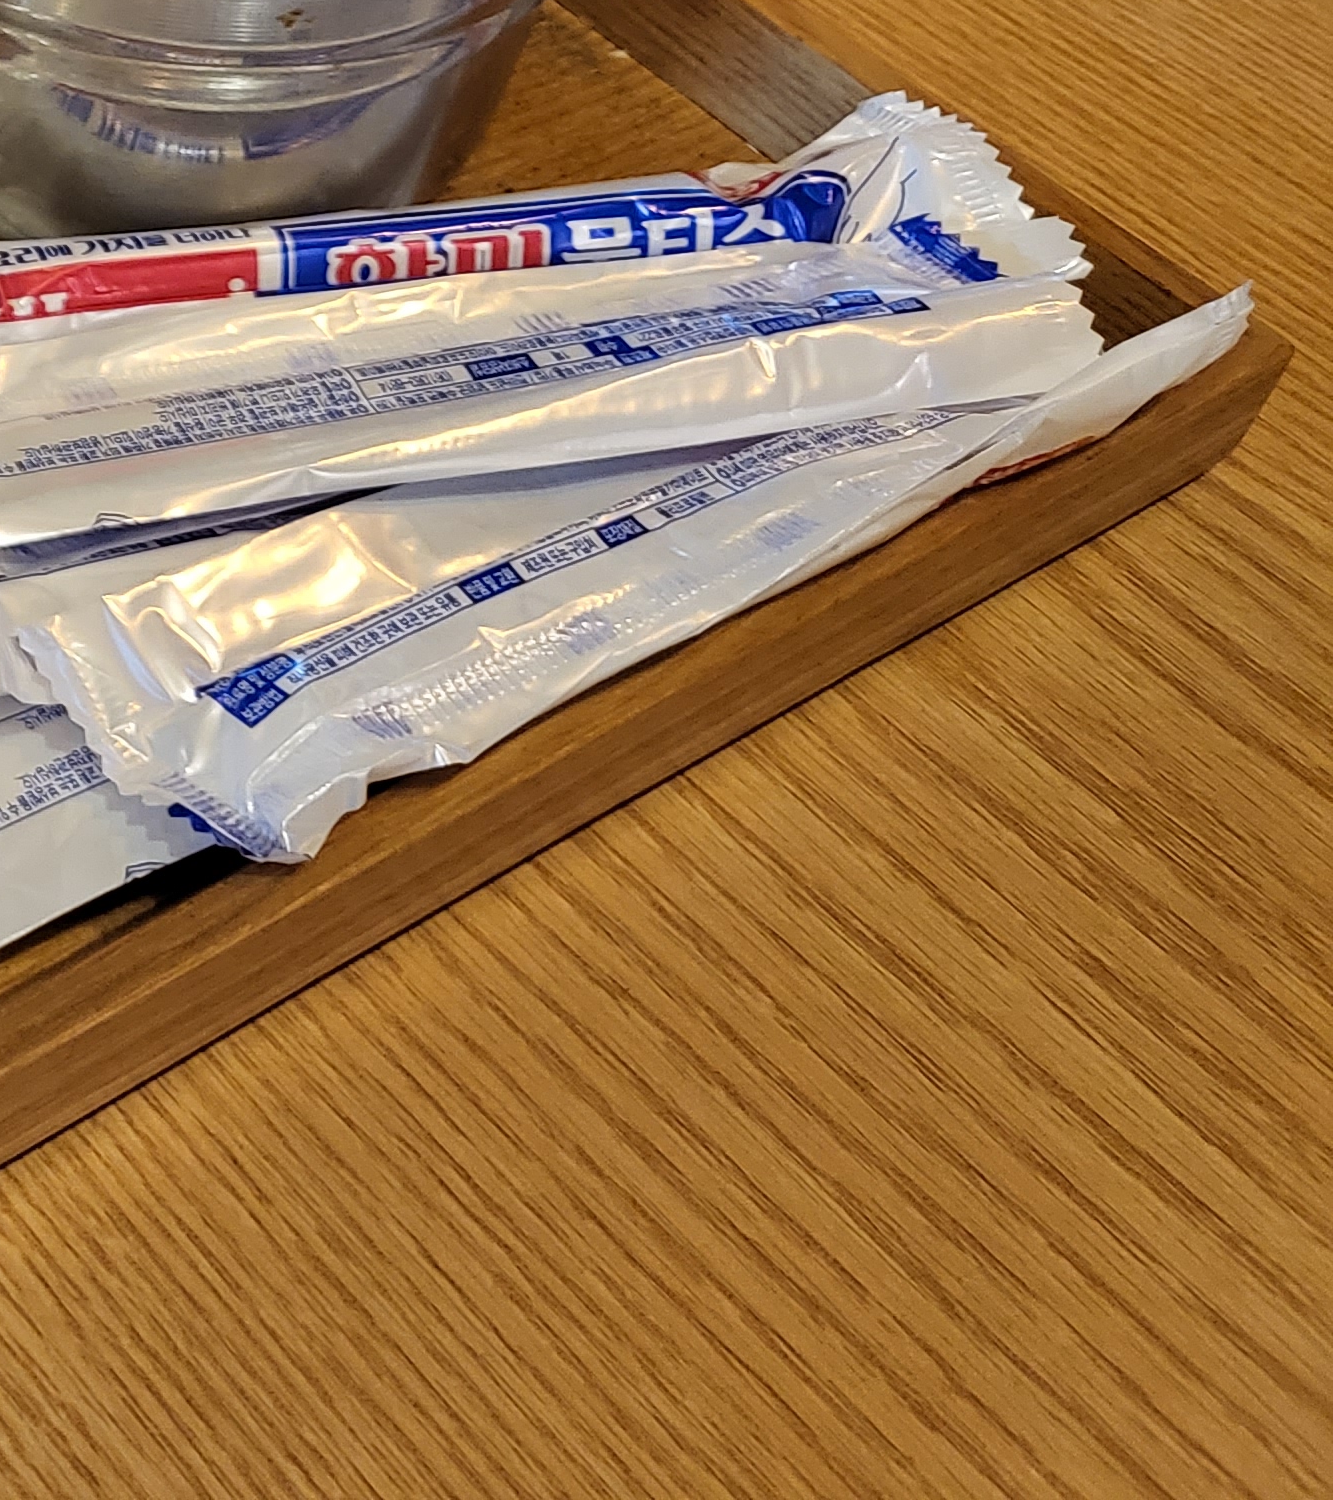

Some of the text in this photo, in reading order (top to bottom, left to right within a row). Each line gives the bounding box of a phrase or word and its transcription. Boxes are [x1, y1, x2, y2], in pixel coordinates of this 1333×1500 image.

[546, 544, 573, 564] 또는
[350, 628, 386, 652] 건조한
[396, 610, 423, 629] 보관
[415, 601, 442, 621] 또는
[433, 592, 461, 611] 유통
[15, 745, 97, 789] 냉장보관하십시오
[55, 773, 80, 794] 또는
[6, 799, 20, 816] 수
[18, 782, 60, 812] 보상받을
